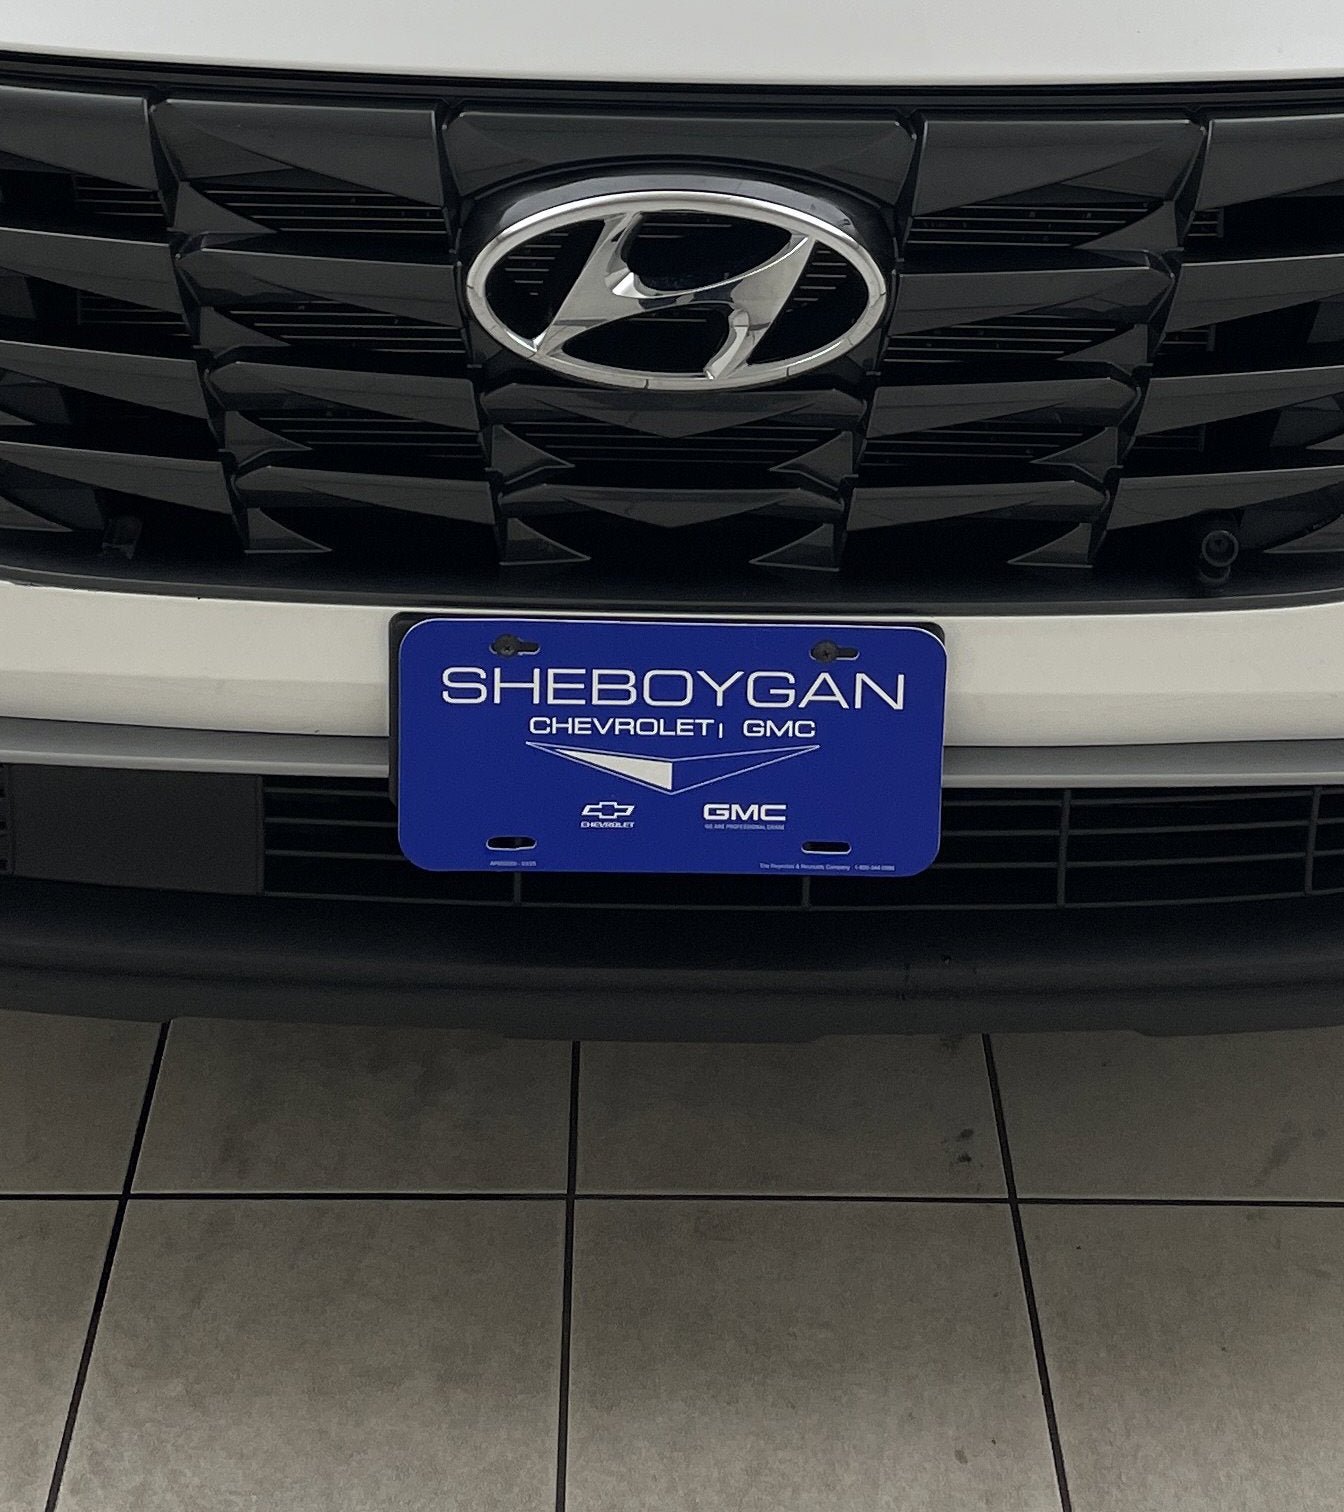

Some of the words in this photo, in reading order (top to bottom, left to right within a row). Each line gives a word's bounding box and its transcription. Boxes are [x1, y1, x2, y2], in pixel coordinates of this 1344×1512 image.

[441, 666, 905, 710] SHEBOYGAN
[528, 716, 715, 736] CHEVROLET
[742, 719, 816, 738] GMC
[703, 803, 787, 821] GMC
